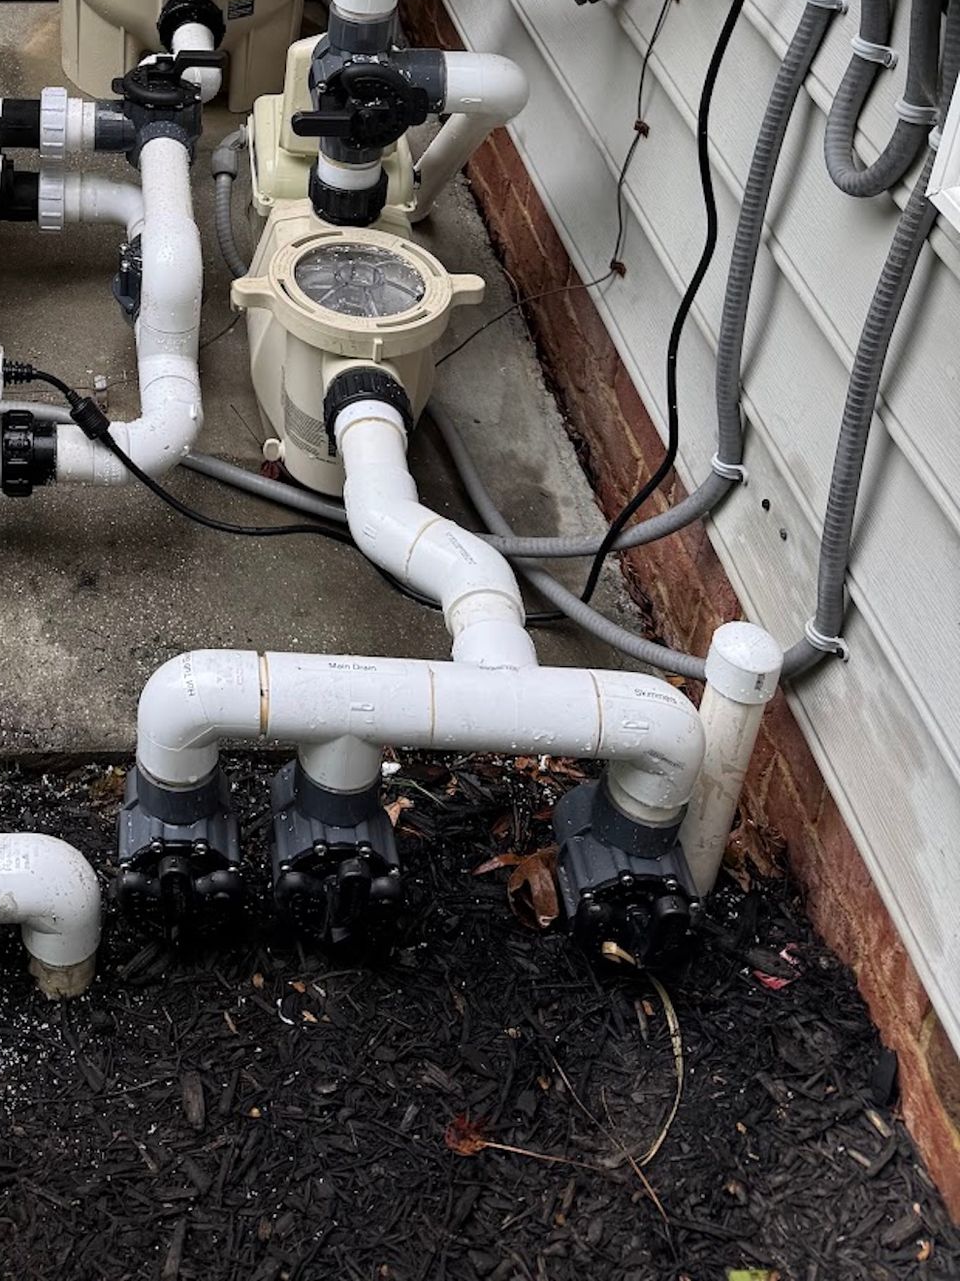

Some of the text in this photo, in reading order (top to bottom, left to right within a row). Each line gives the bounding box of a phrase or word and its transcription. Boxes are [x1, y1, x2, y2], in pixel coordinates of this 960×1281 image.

[328, 662, 378, 672] Main Drain
[633, 687, 678, 705] Skimmers
